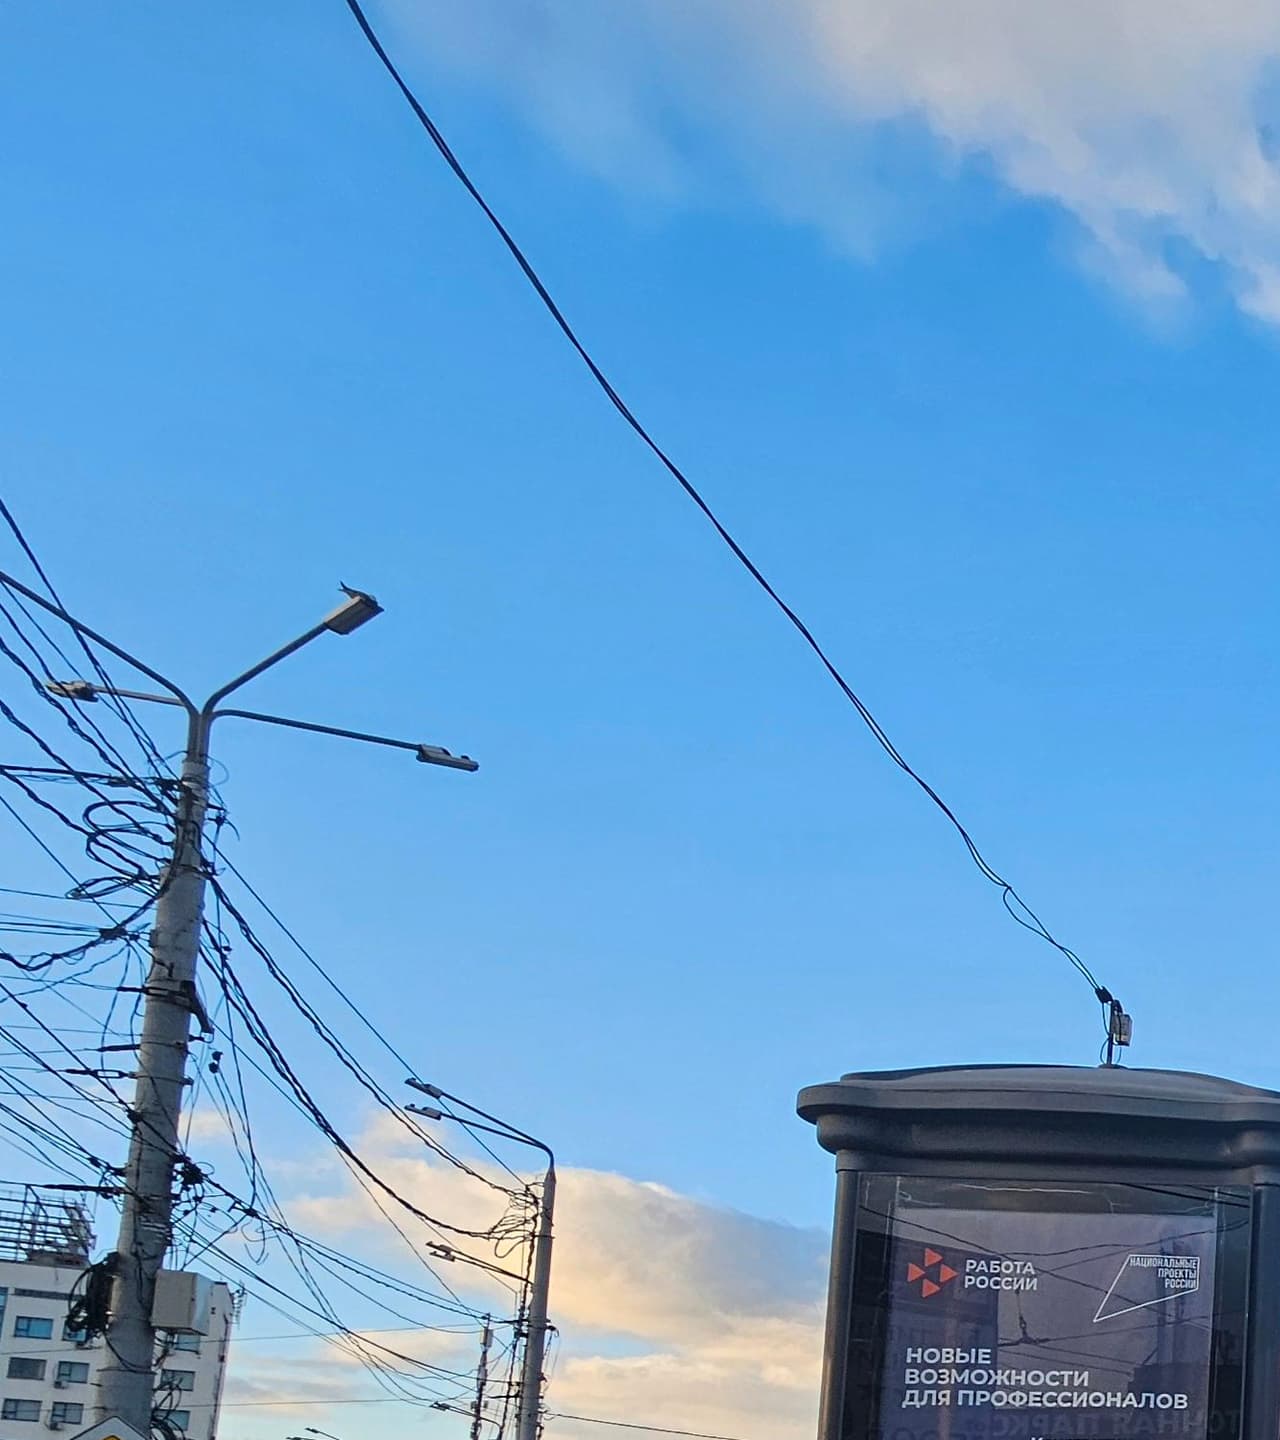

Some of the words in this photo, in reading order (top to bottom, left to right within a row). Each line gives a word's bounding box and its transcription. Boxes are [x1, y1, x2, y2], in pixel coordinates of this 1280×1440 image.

[965, 1260, 1035, 1275] РАБОТА
[1130, 1257, 1197, 1269] НАЦИОНАЛЬНЫЕ
[1158, 1268, 1197, 1278] ПРОЕКТЫ
[964, 1275, 1038, 1291] РОССИИ
[1164, 1279, 1196, 1288] РОССИИ
[906, 1347, 991, 1364] НОВЫЕ
[904, 1369, 1089, 1387] ВОЗМОЖНОСТИ
[902, 1389, 951, 1408] ДЛЯ
[957, 1389, 1189, 1410] ПРОФЕССИОНАЛОВ
